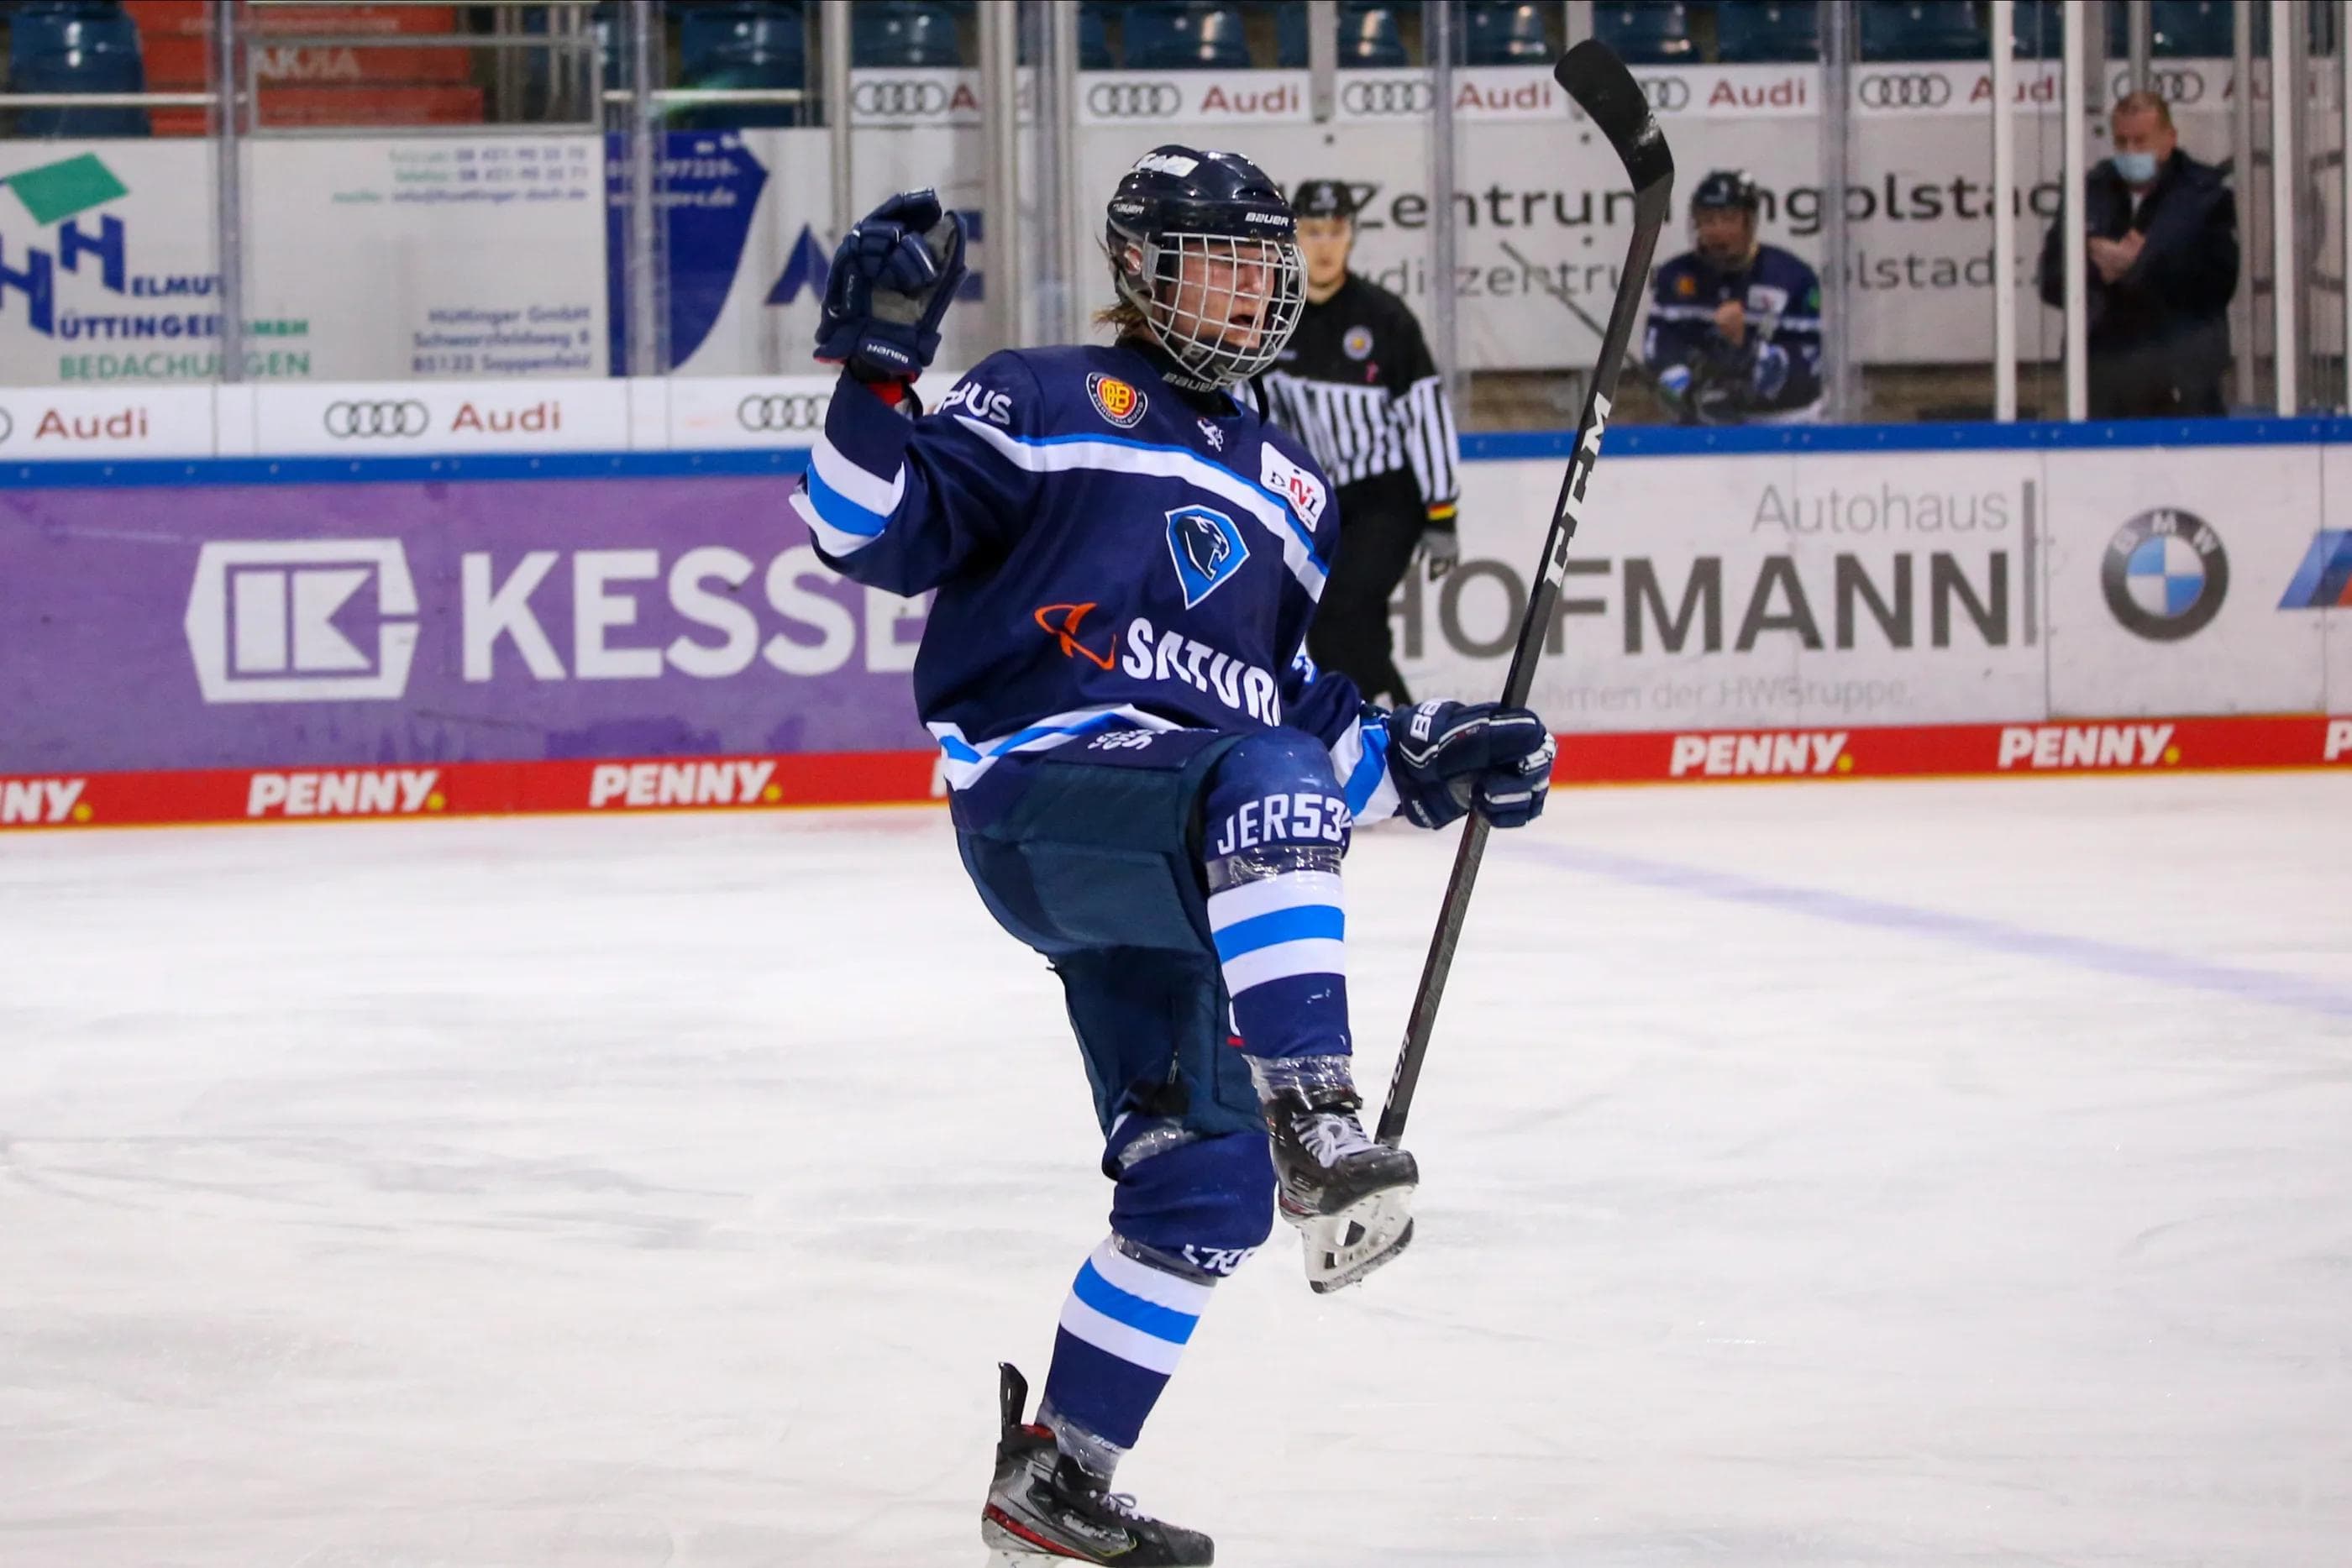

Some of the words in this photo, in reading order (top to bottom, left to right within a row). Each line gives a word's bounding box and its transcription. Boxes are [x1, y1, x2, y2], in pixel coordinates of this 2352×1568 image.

[1201, 83, 1300, 113] Audi
[1455, 81, 1552, 111] Audi
[1708, 78, 1807, 108] Audi
[35, 408, 149, 438] Audi
[451, 402, 561, 433] Audi
[1751, 482, 2008, 534] Autohaus
[2113, 511, 2218, 555] BMW
[462, 546, 934, 682] KESSE
[1389, 550, 2009, 660] HOFMANN
[1122, 616, 1281, 727] SATUR
[0, 779, 91, 823] NY.
